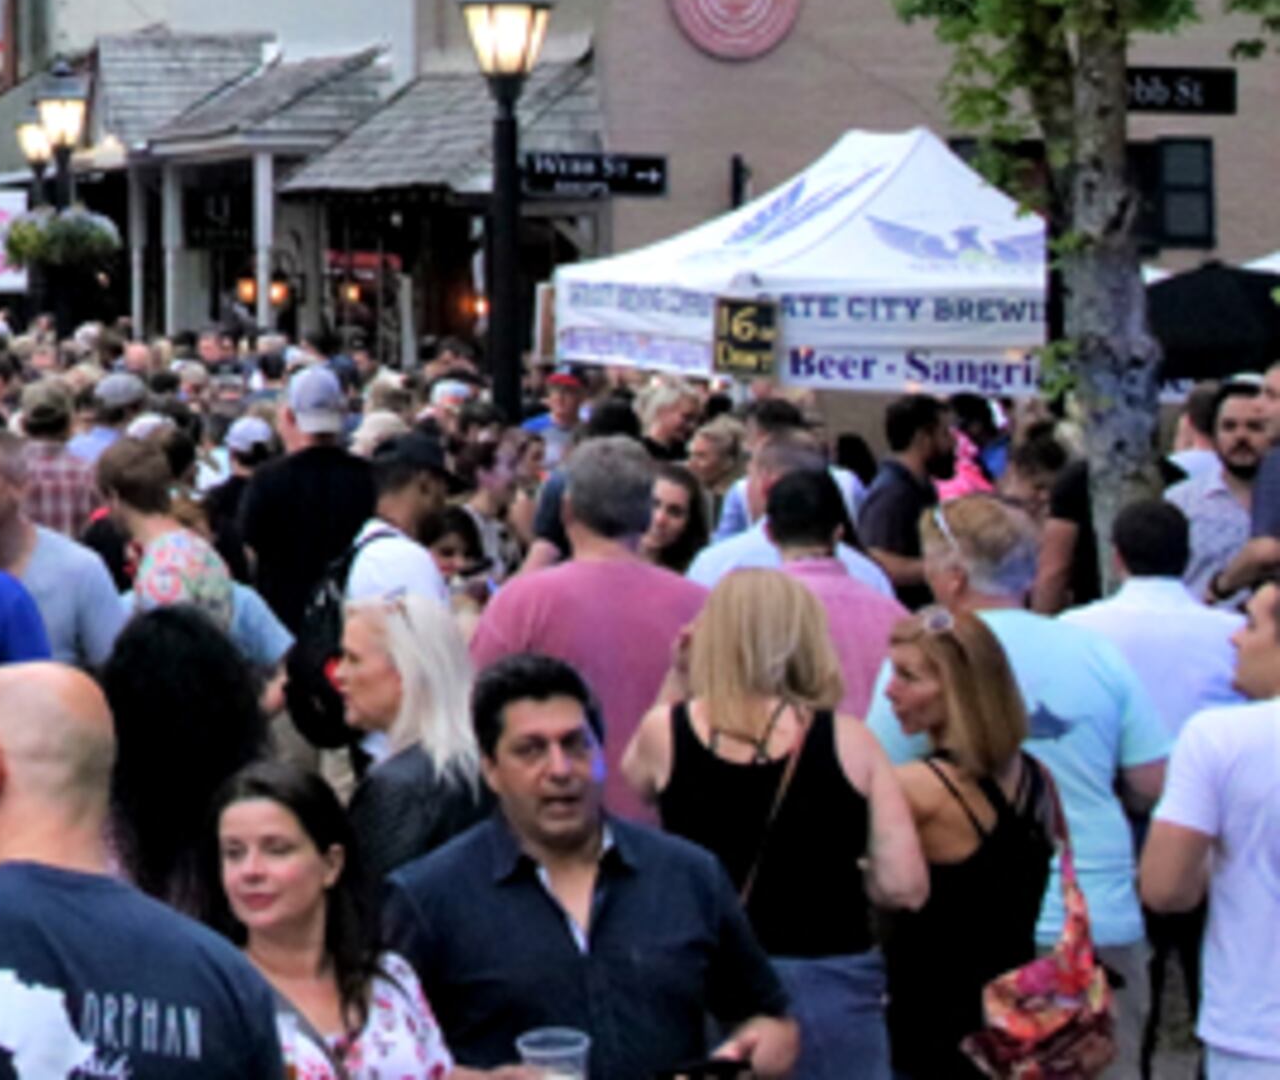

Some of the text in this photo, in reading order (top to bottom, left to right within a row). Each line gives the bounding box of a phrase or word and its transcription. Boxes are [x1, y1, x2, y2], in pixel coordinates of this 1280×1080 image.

[776, 293, 1038, 322] ATE CITY BREWI
[790, 347, 876, 378] Beer
[904, 348, 1040, 391] Sangri
[79, 990, 201, 1062] ORPHAN
